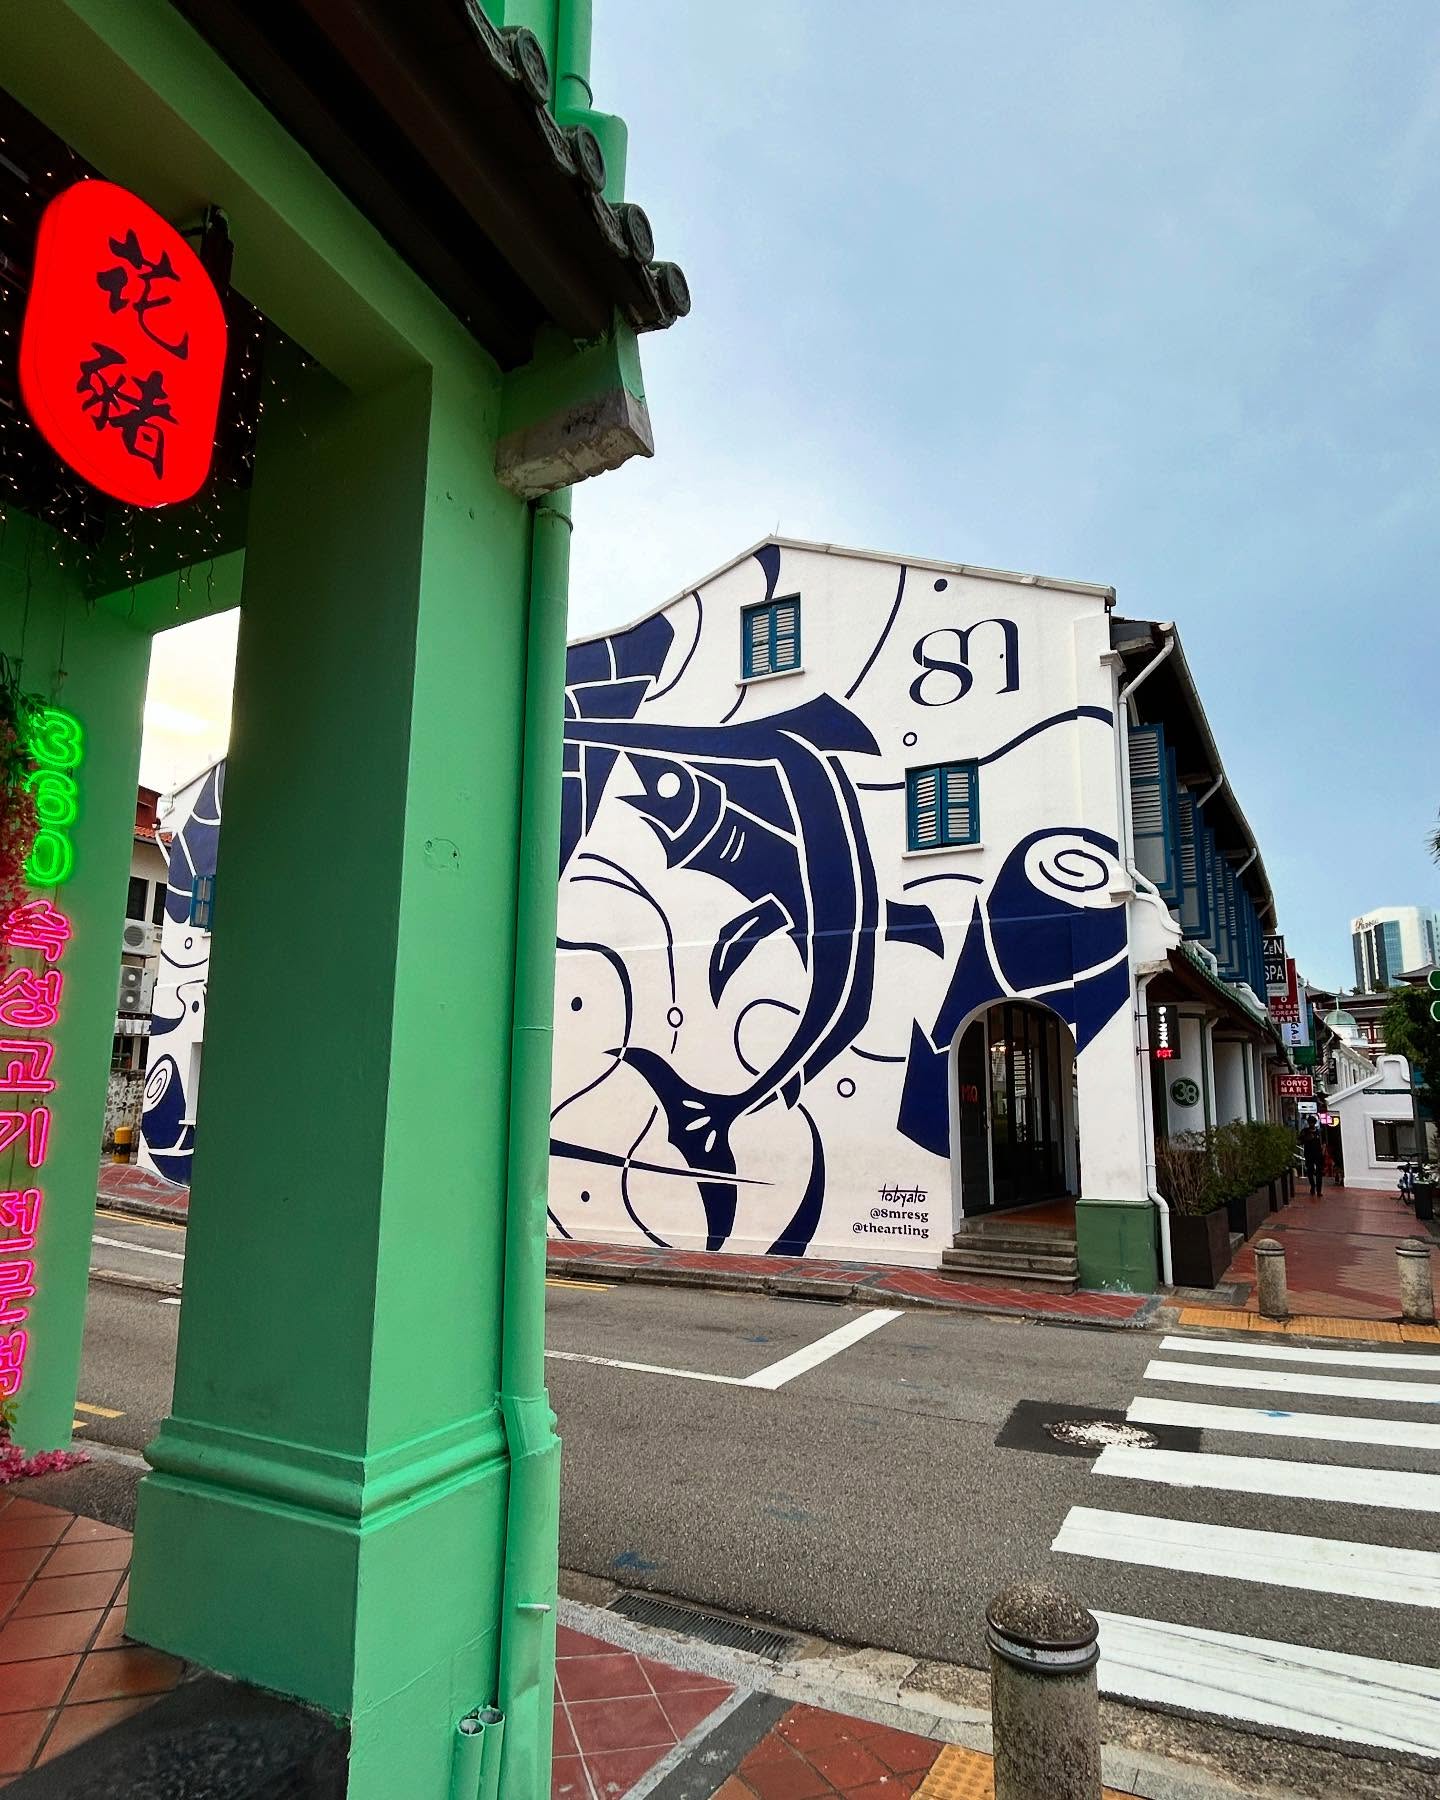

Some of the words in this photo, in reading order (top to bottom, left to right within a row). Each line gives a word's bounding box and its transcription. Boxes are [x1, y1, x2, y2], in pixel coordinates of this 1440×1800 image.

[28, 708, 83, 884] 360
[1264, 965, 1285, 981] SPA
[1158, 1006, 1169, 1048] PIZZA
[1174, 1081, 1198, 1104] 38
[870, 1208, 929, 1223] @8mresg
[852, 1222, 929, 1239] @theartling
